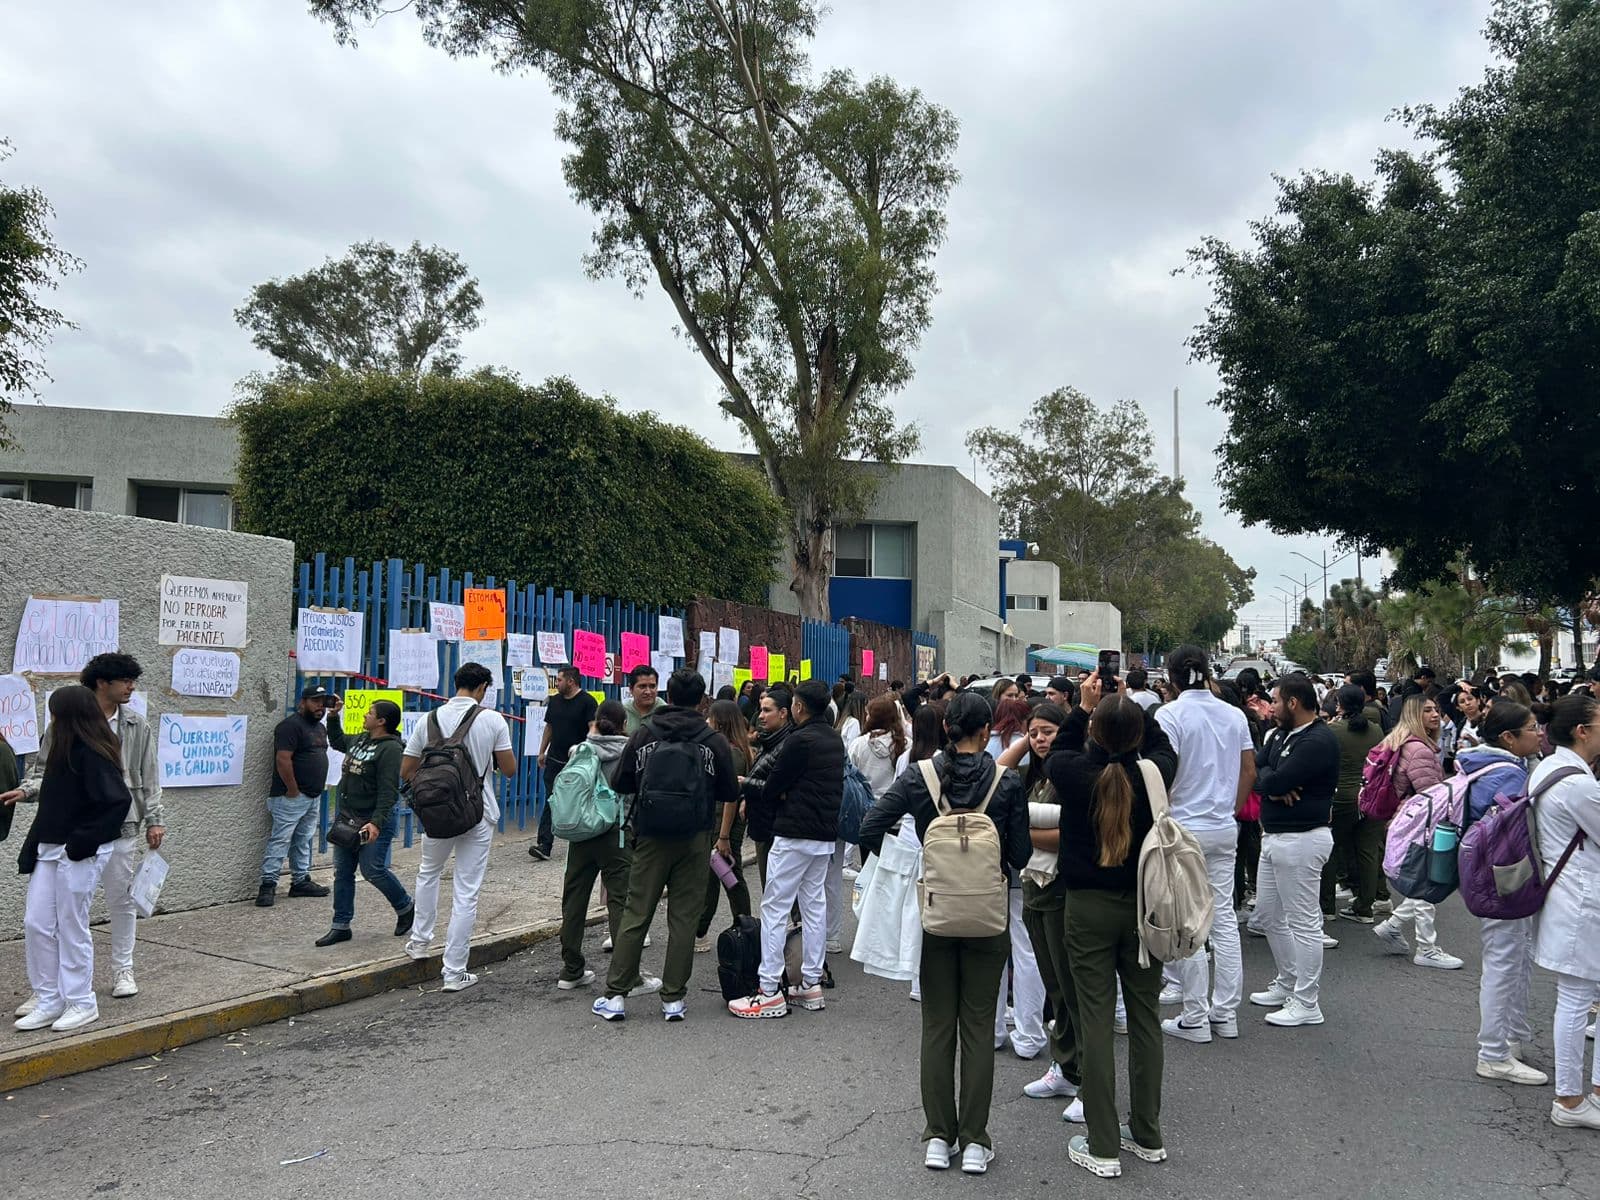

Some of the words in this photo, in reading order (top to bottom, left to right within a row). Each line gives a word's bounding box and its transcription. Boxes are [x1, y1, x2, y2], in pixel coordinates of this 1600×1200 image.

[165, 578, 209, 598] QUEREMOS
[163, 600, 180, 615] NO
[184, 602, 228, 620] REPROBAR
[162, 618, 177, 628] POR
[180, 620, 201, 630] FALTA
[203, 621, 214, 630] DE
[176, 630, 225, 646] PACIENTES
[303, 638, 345, 652] ADECUADOS
[199, 681, 233, 696] INAPAM
[346, 694, 366, 710] 350
[182, 743, 235, 759] UNIDADES
[165, 761, 181, 778] DE
[184, 760, 230, 776] CALIDAD
